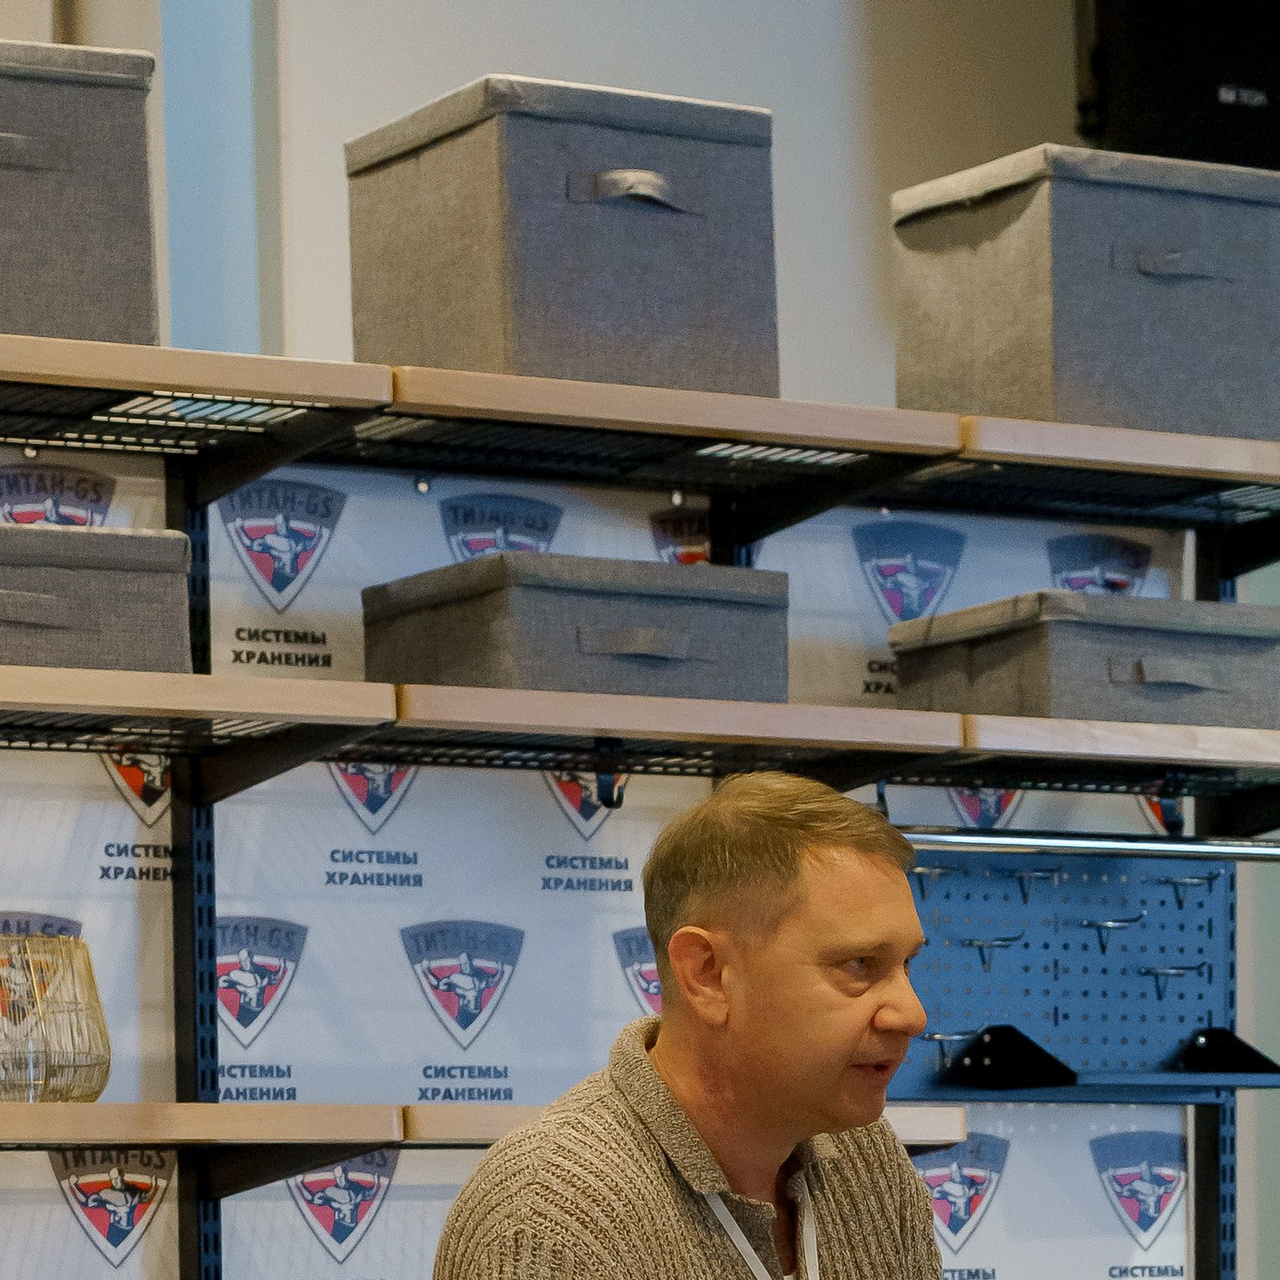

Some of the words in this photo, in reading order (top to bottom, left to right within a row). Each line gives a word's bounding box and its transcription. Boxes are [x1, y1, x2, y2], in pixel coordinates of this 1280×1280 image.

[0, 473, 102, 503] ИТАН-GS
[235, 627, 326, 645] СИСТЕМЫ
[232, 650, 332, 667] ХРАНЕНИЯ
[104, 843, 172, 858] СИСТЕ
[330, 849, 418, 865] СИСТЕМЫ
[545, 855, 628, 870] СИСТЕМЫ
[99, 866, 172, 881] ХРАНЕН
[325, 871, 423, 887] ХРАНЕНИЯ
[541, 877, 633, 891] ХРАНЕНИЯ
[216, 925, 295, 952] ТАН-GS
[218, 1065, 291, 1078] ИСТЕМЫ
[422, 1065, 508, 1079] СИСТЕМЫ
[219, 1087, 297, 1101] АНЕНИЯ
[418, 1087, 513, 1101] ХРАНЕНИЯ
[942, 1268, 996, 1280] СТЕМЫ
[1108, 1265, 1184, 1278] СИСТЕМЫ
